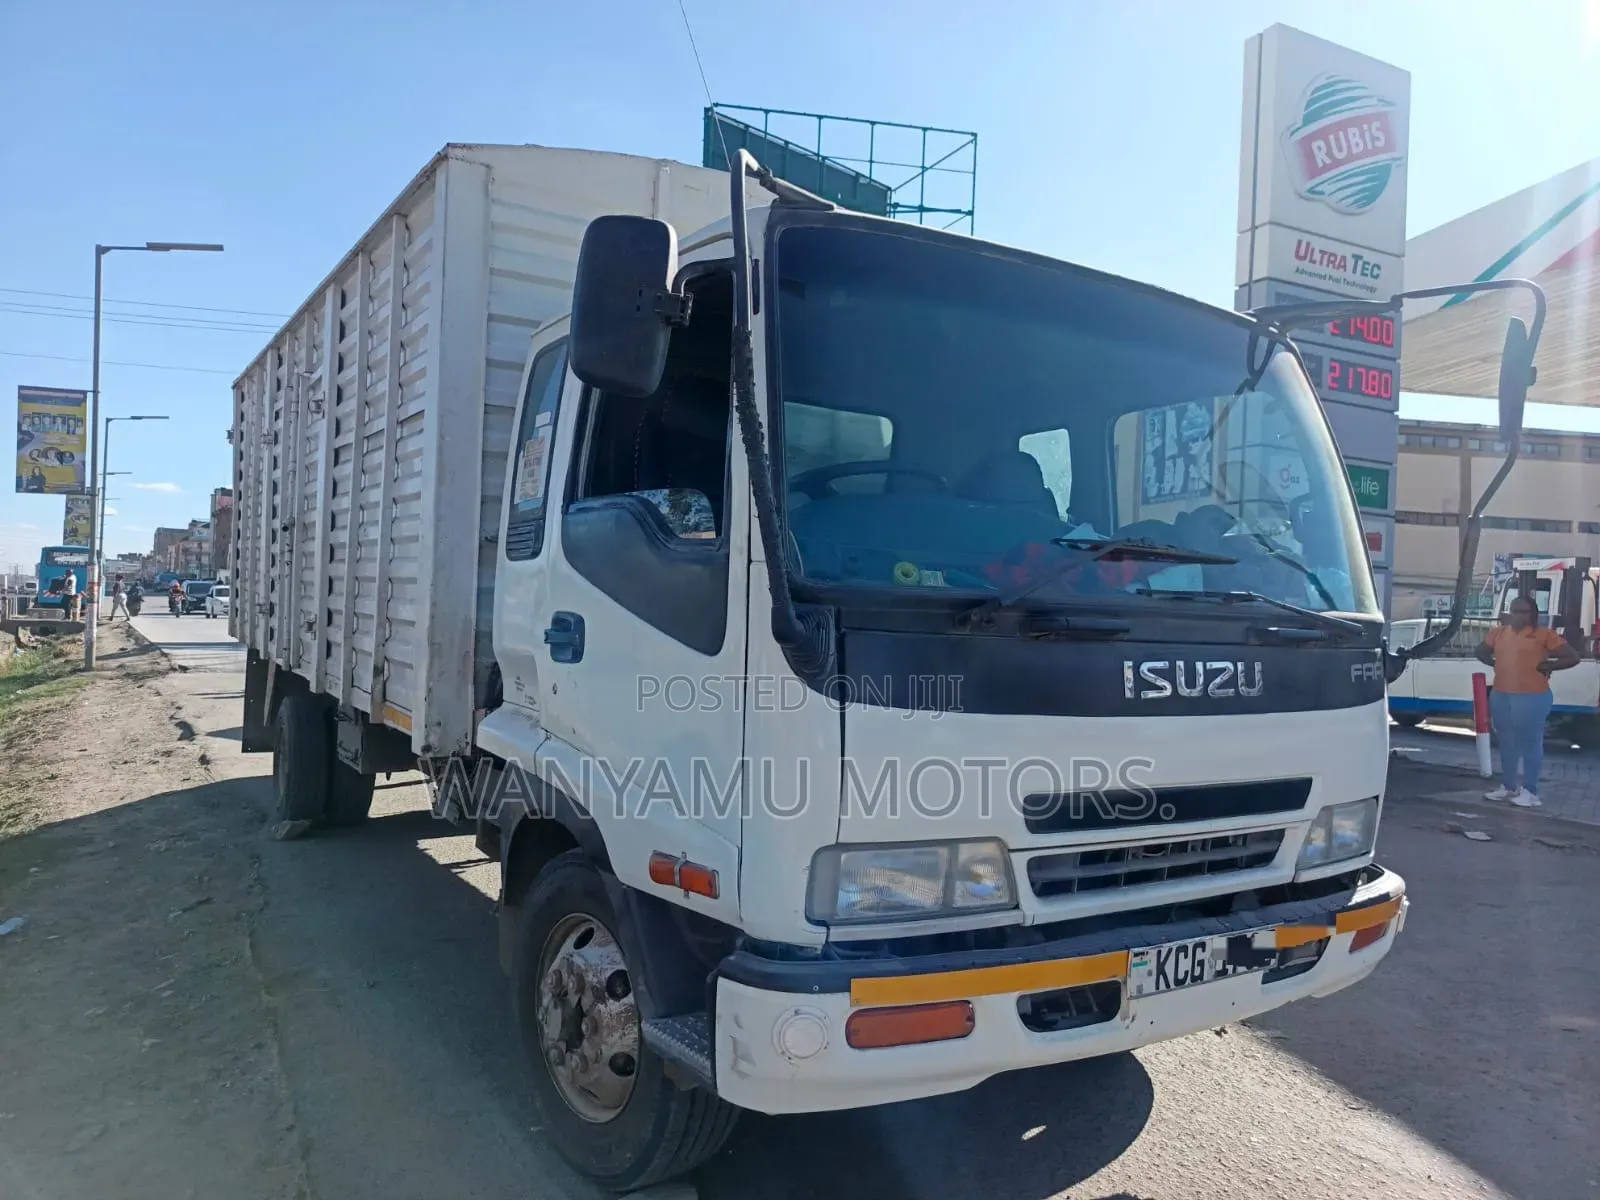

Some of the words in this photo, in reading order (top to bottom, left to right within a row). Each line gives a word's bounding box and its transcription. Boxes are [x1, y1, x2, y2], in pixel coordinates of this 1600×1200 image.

[1295, 266, 1327, 281] Advanced
[1328, 274, 1342, 285] Fuel
[1343, 278, 1378, 294] Technology
[1361, 475, 1380, 496] life
[1123, 660, 1263, 699] ISUZU
